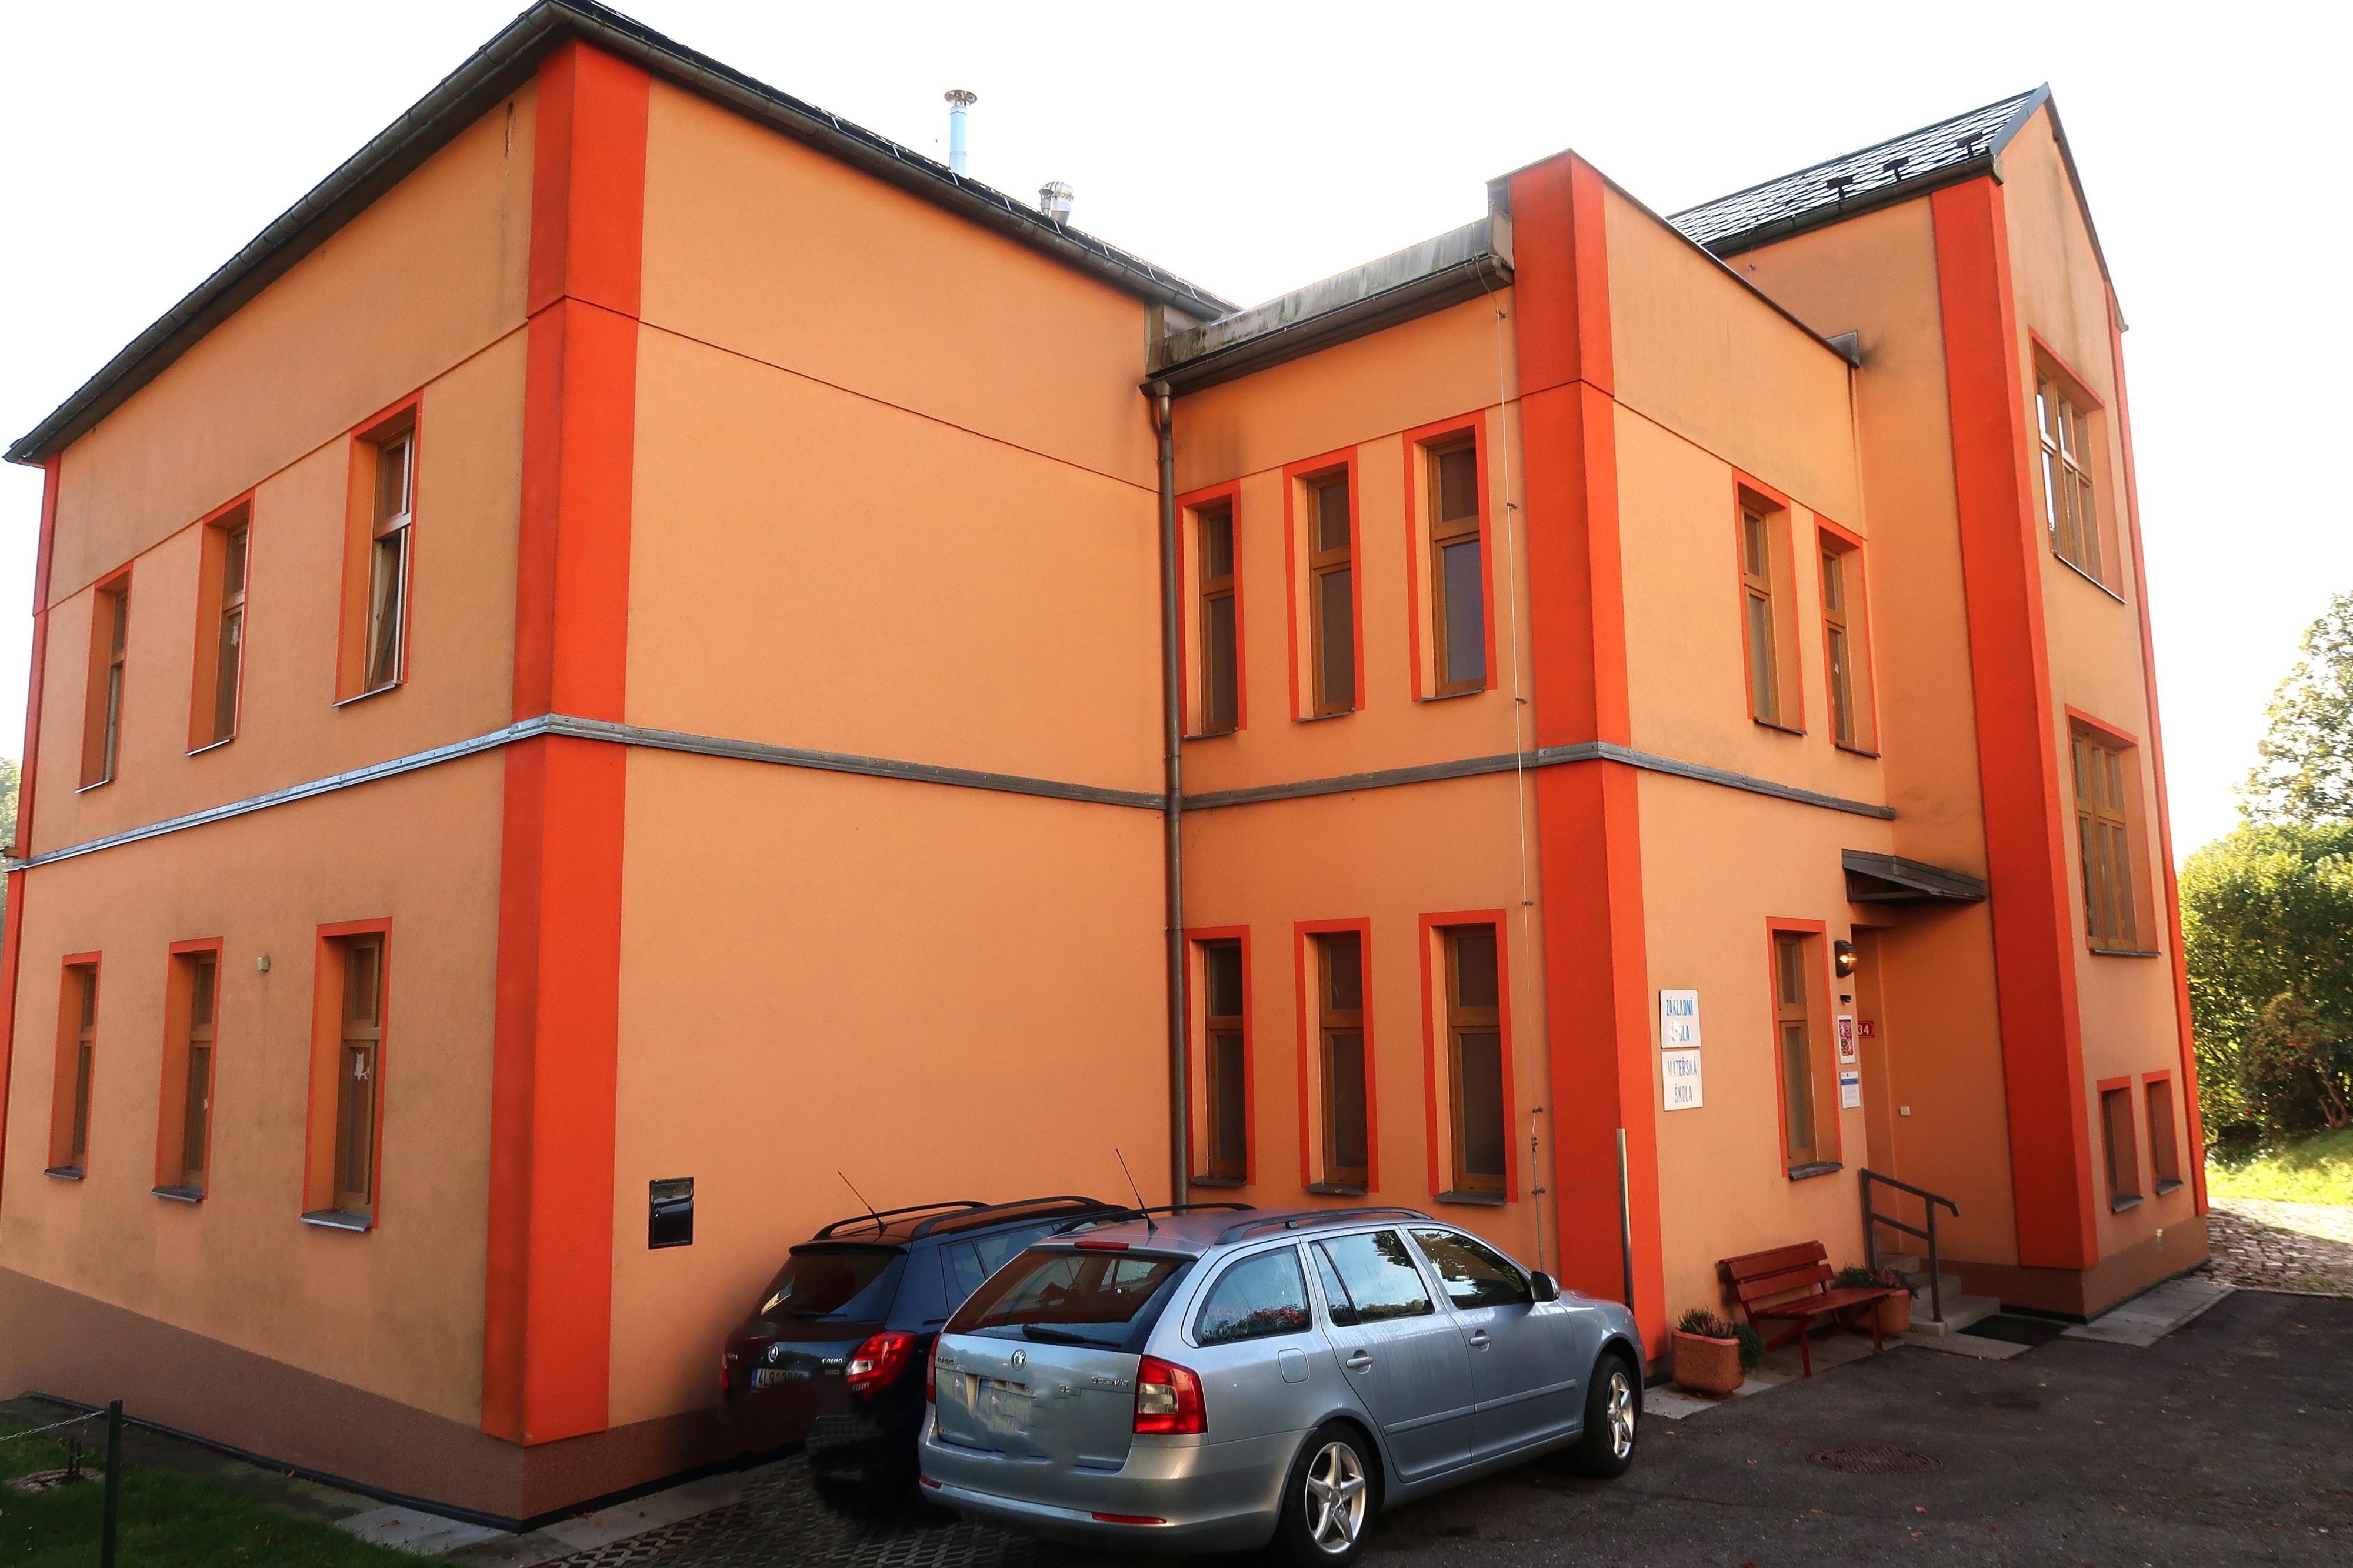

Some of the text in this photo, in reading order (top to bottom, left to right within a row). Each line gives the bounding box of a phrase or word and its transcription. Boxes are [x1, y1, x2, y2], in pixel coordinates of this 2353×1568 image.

[1666, 996, 1694, 1016] ZÁKLADNÍ
[1858, 1024, 1869, 1035] 34
[1667, 1056, 1697, 1077] MATEŘSKÁ
[1674, 1083, 1693, 1103] ŠKOLA
